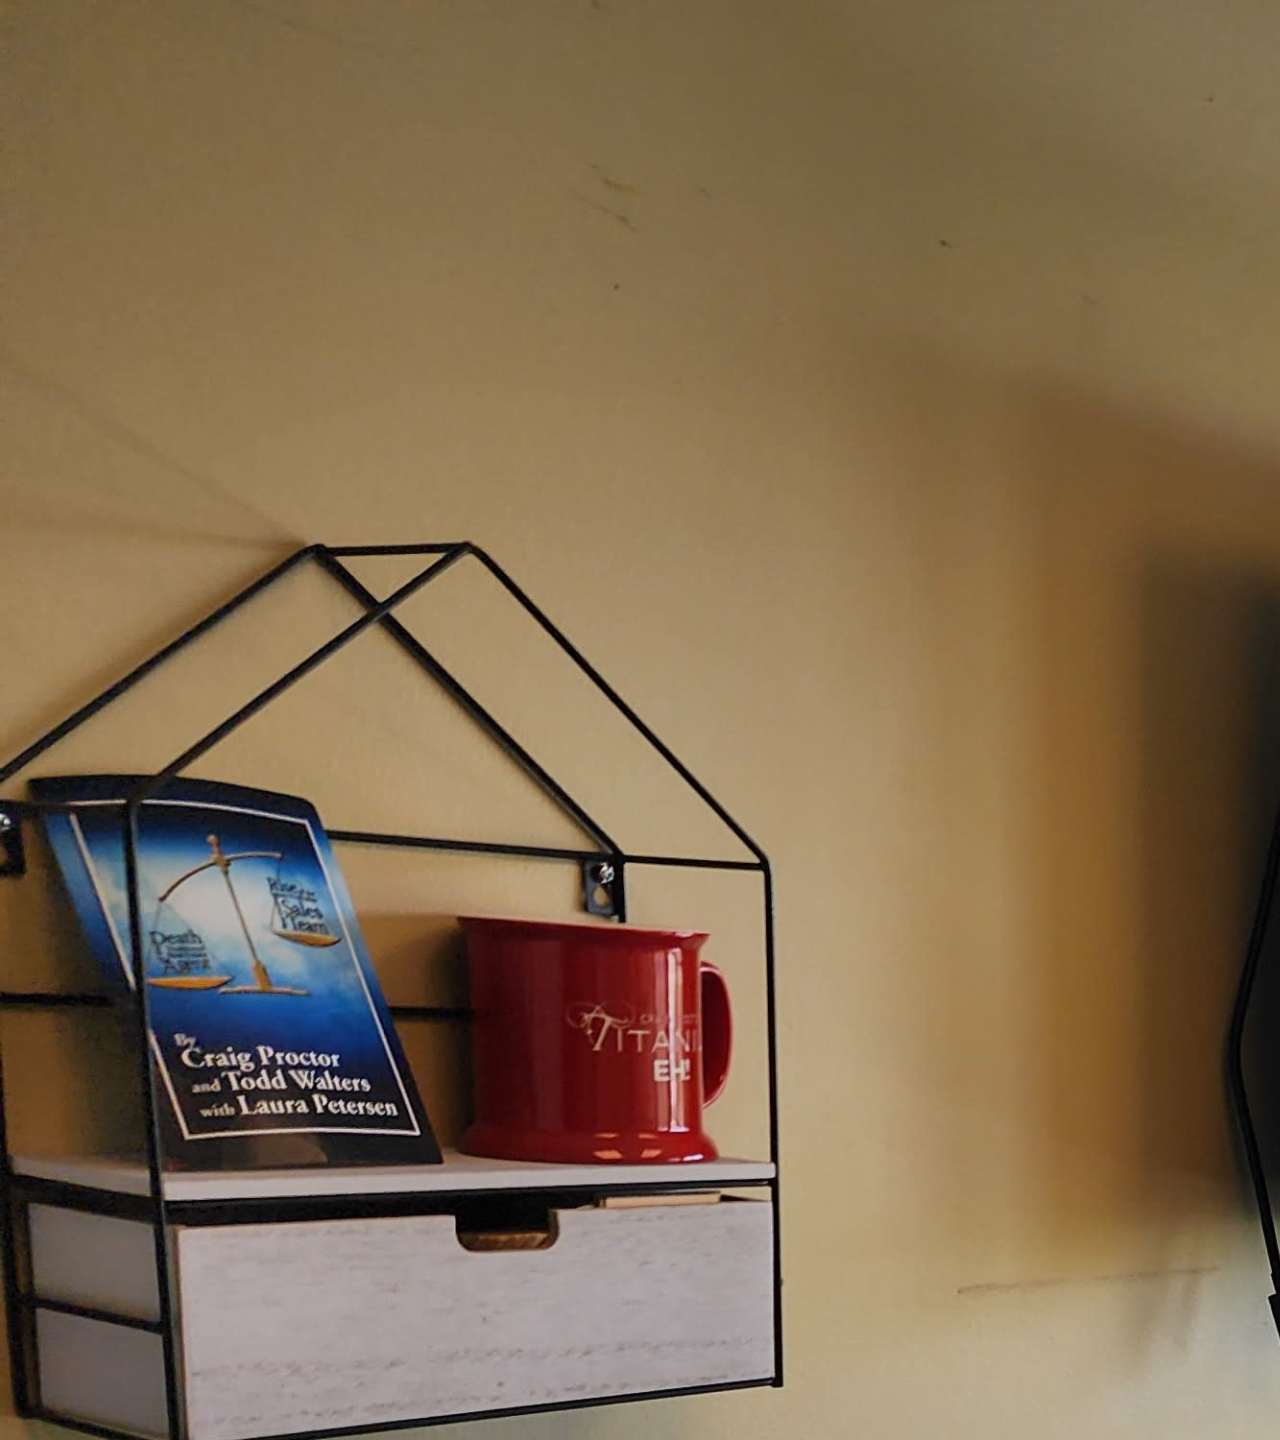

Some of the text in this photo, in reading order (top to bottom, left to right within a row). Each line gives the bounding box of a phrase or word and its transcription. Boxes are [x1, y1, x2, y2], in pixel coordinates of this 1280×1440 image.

[181, 1045, 341, 1071] Craig Proctor
[192, 1069, 371, 1093] and Todd Walters
[200, 1093, 399, 1117] with Laura Petersen
